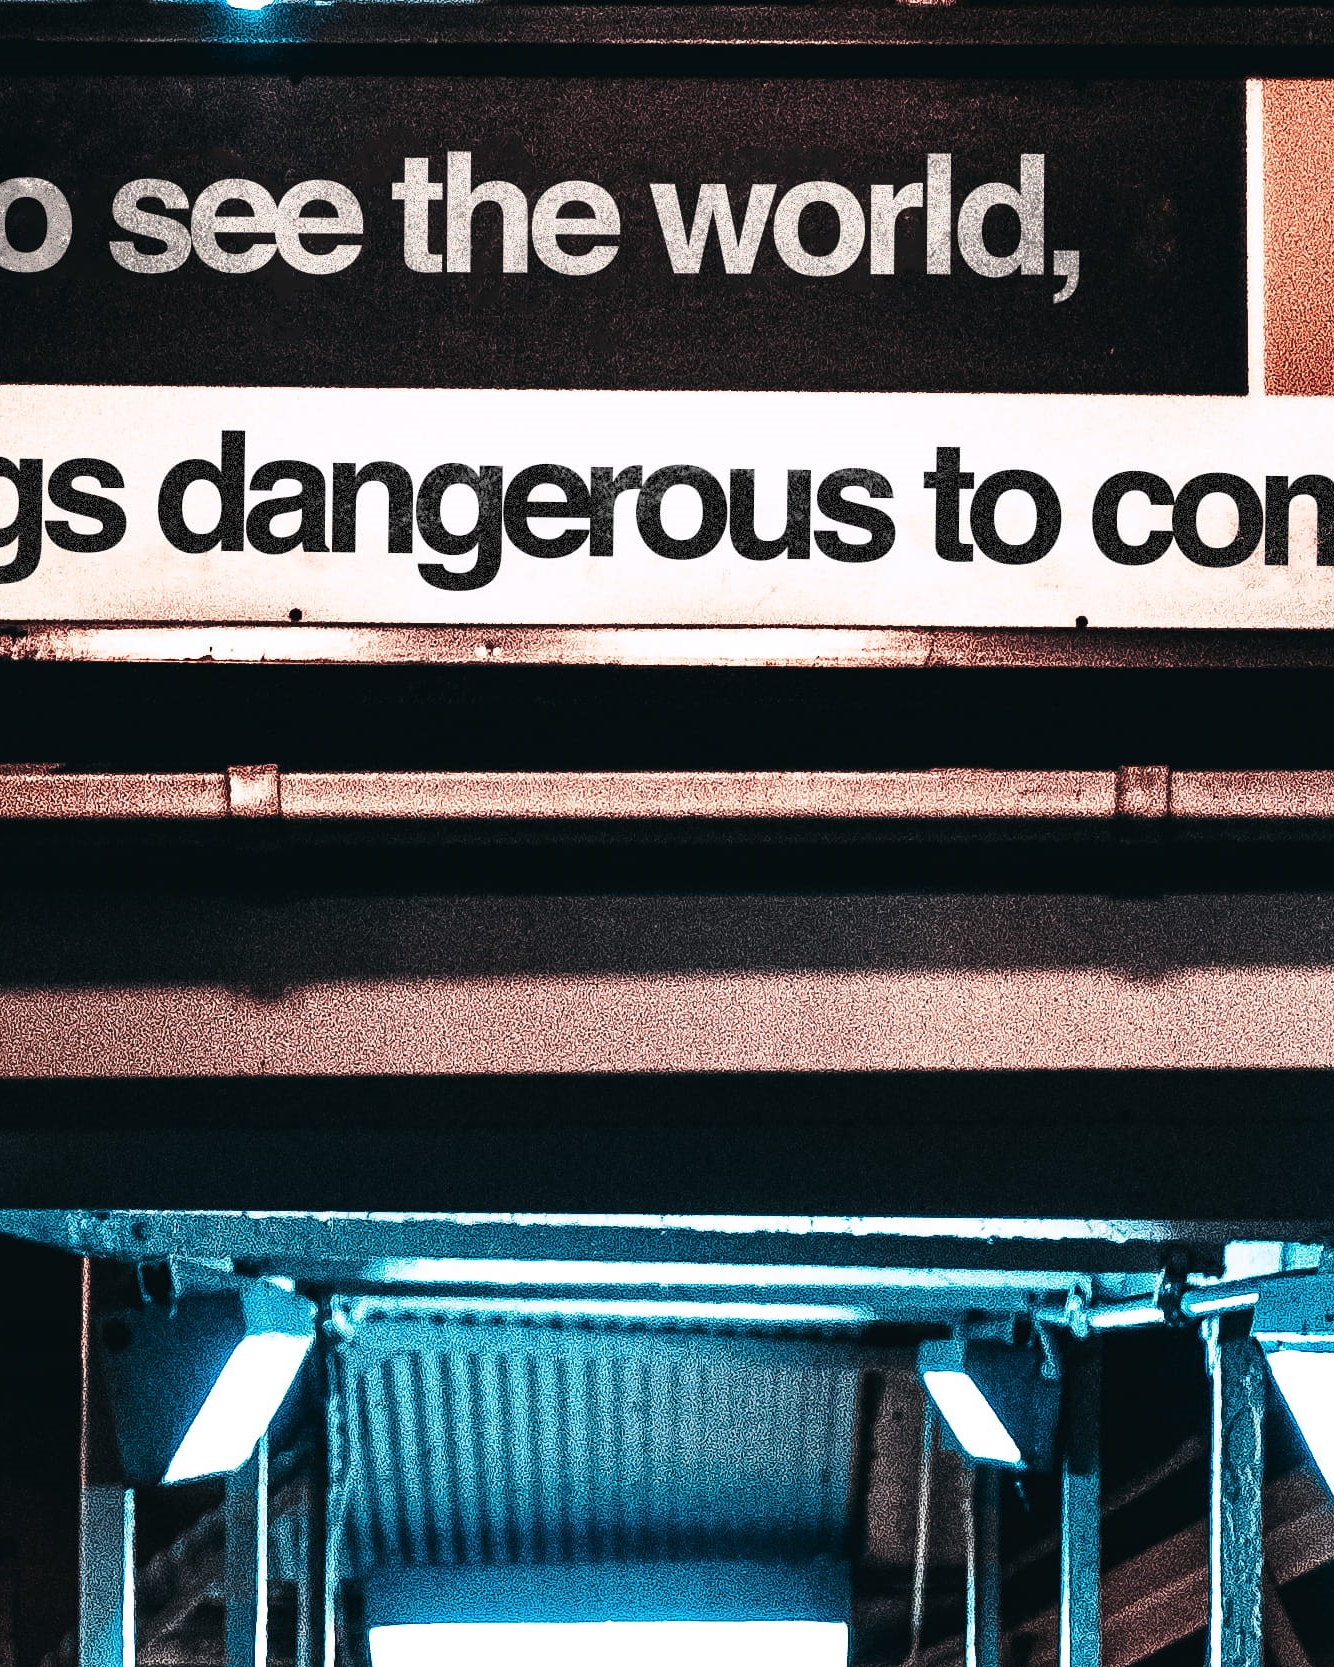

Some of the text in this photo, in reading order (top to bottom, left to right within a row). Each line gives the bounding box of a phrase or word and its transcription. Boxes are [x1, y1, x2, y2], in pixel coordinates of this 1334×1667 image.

[108, 178, 364, 275] see
[391, 151, 622, 276] the
[650, 152, 1081, 305] world,
[158, 429, 896, 592] dangerous
[924, 446, 1062, 567] to
